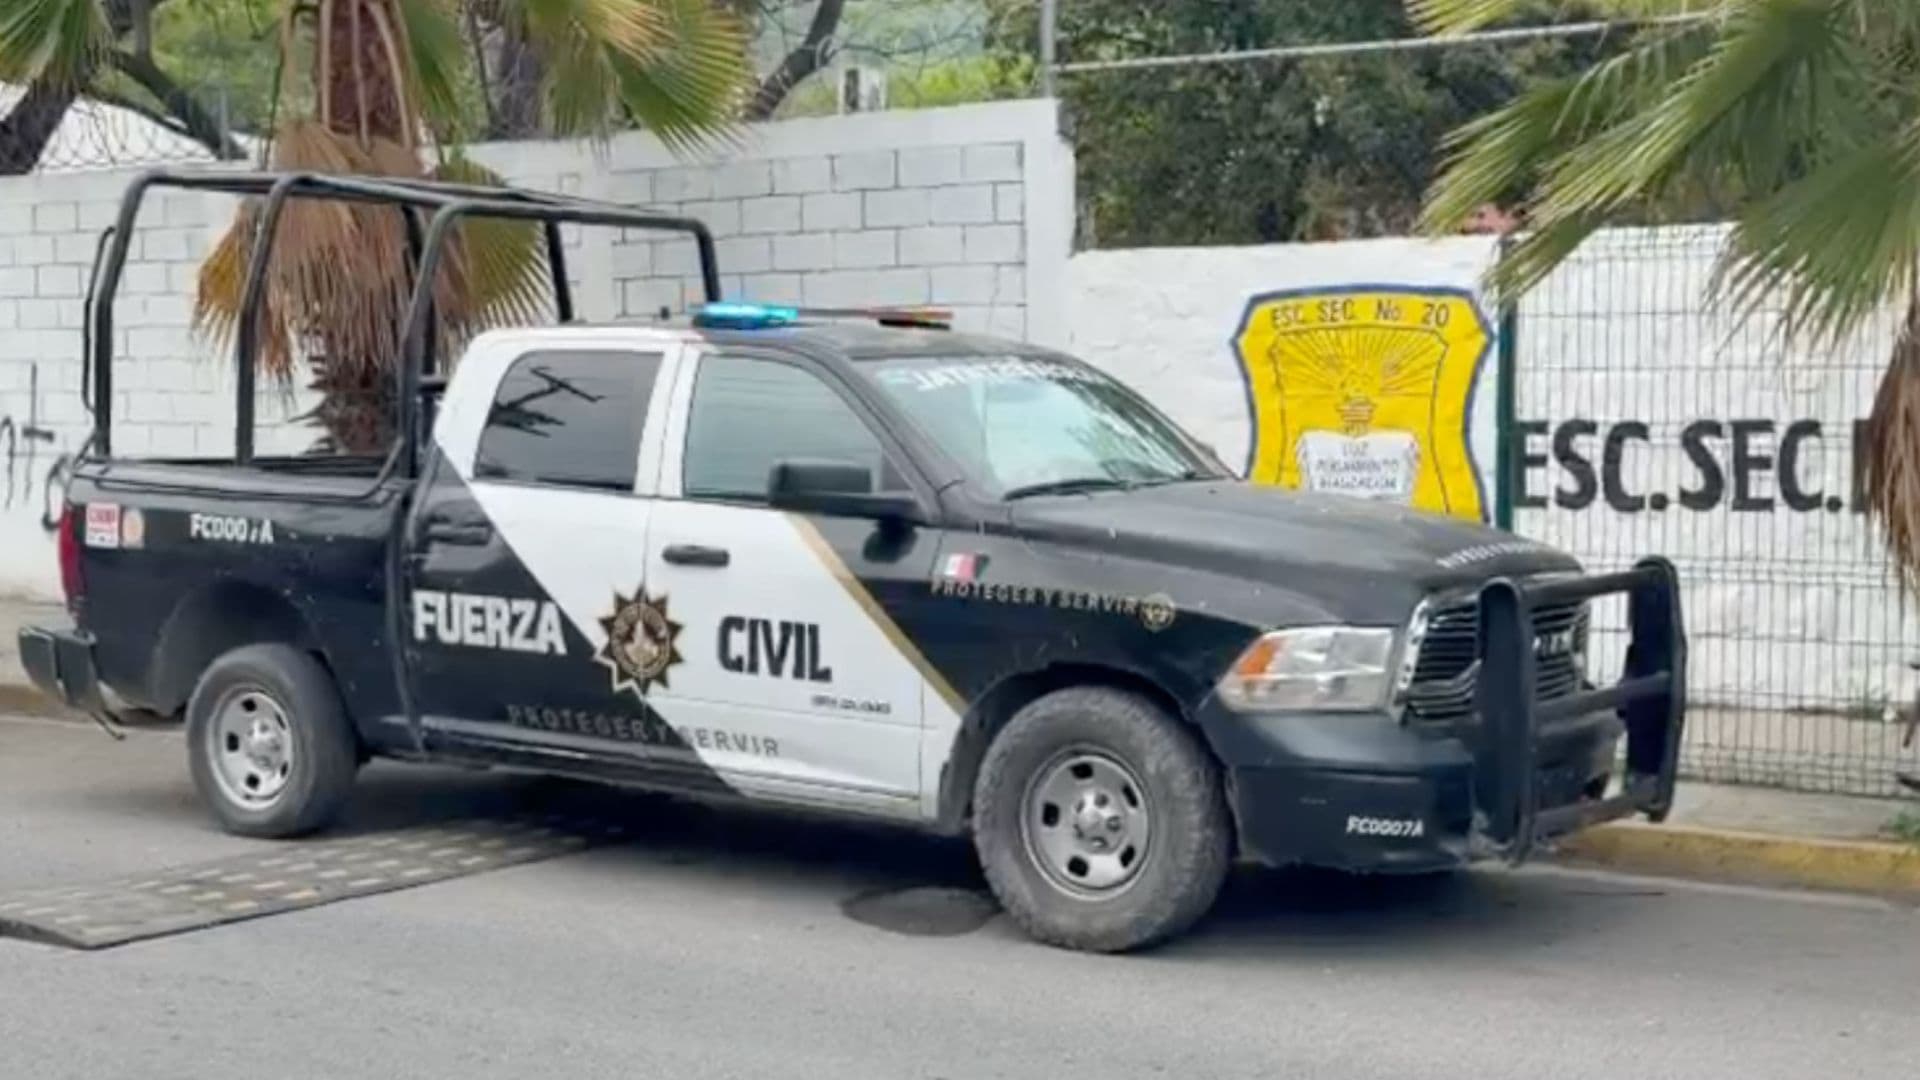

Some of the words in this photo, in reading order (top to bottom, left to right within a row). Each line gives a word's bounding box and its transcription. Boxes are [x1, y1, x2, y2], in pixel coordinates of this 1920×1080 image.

[1421, 302, 1449, 327] 20
[411, 590, 567, 655] FUERZA
[718, 614, 832, 683] CIVIL
[505, 704, 649, 742] PROTEGER
[681, 727, 779, 757] SERVIR
